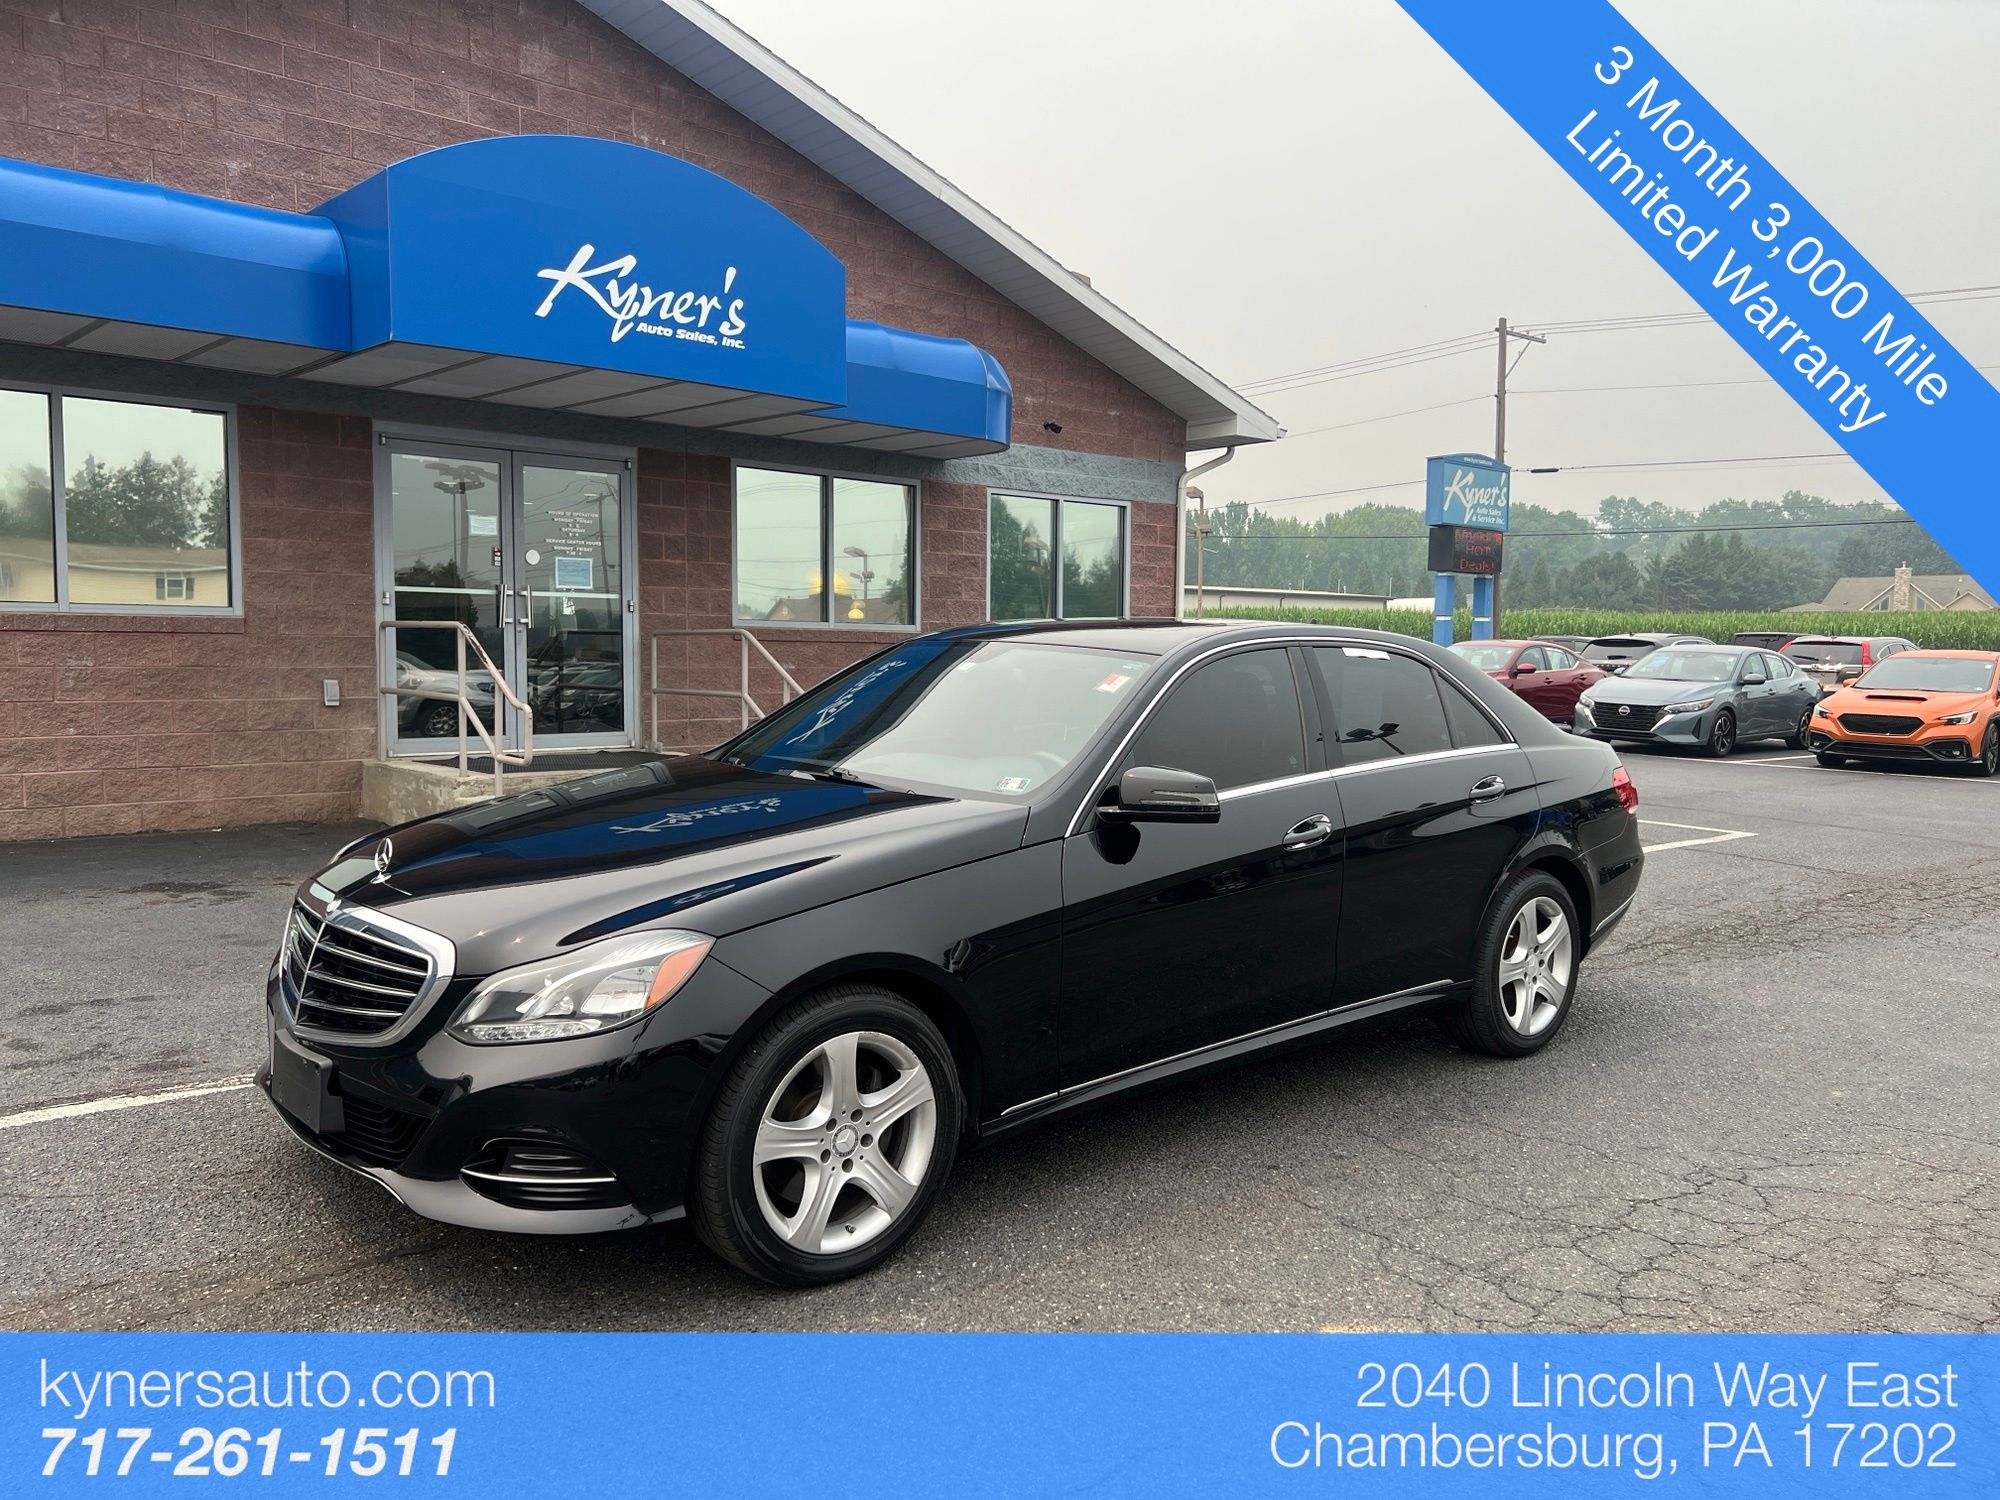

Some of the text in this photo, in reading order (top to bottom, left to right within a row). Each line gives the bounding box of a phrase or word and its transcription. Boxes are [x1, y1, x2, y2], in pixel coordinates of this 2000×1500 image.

[535, 243, 746, 343] Kyner's
[636, 322, 746, 349] Auto Sales, Inc.
[1443, 469, 1507, 524] Kyner's
